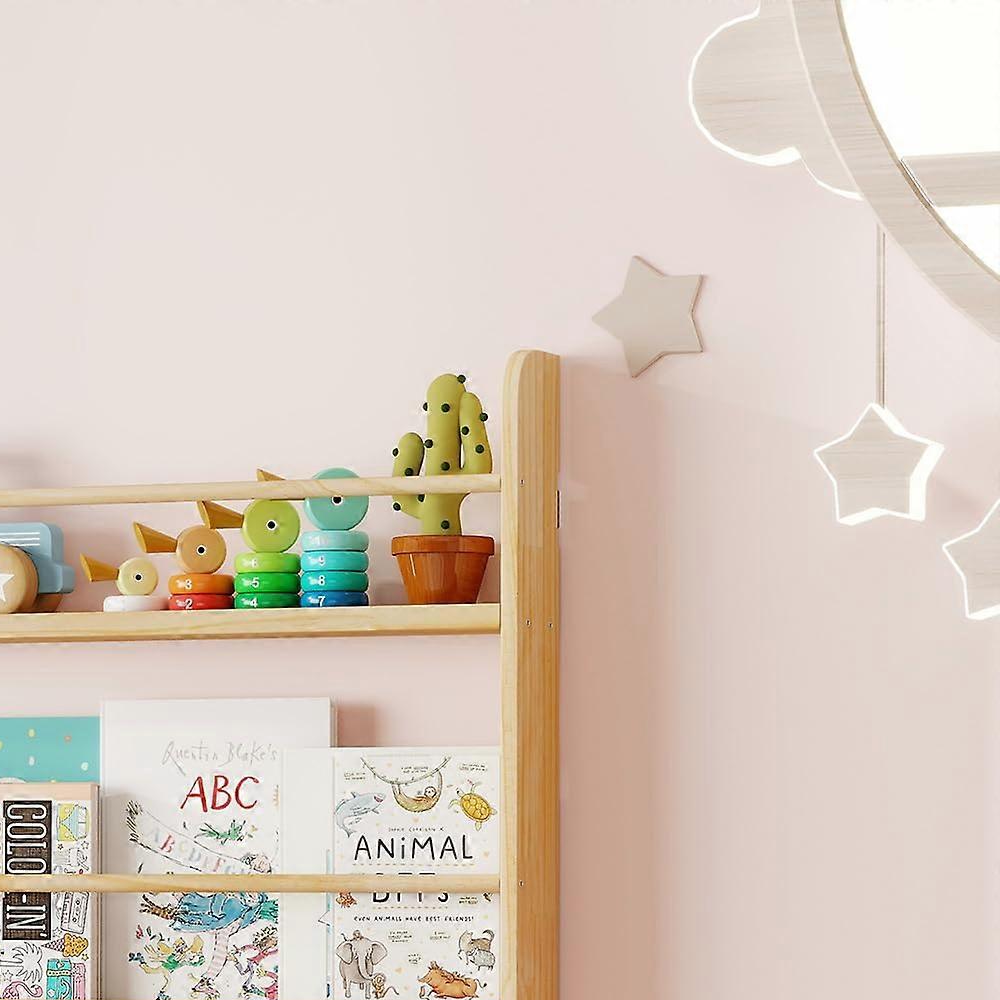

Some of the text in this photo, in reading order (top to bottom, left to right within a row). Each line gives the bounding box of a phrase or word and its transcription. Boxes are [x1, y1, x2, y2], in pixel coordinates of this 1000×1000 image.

[318, 575, 326, 586] 8
[318, 596, 326, 607] 7
[162, 741, 218, 775] Quentin
[180, 775, 260, 812] ABC
